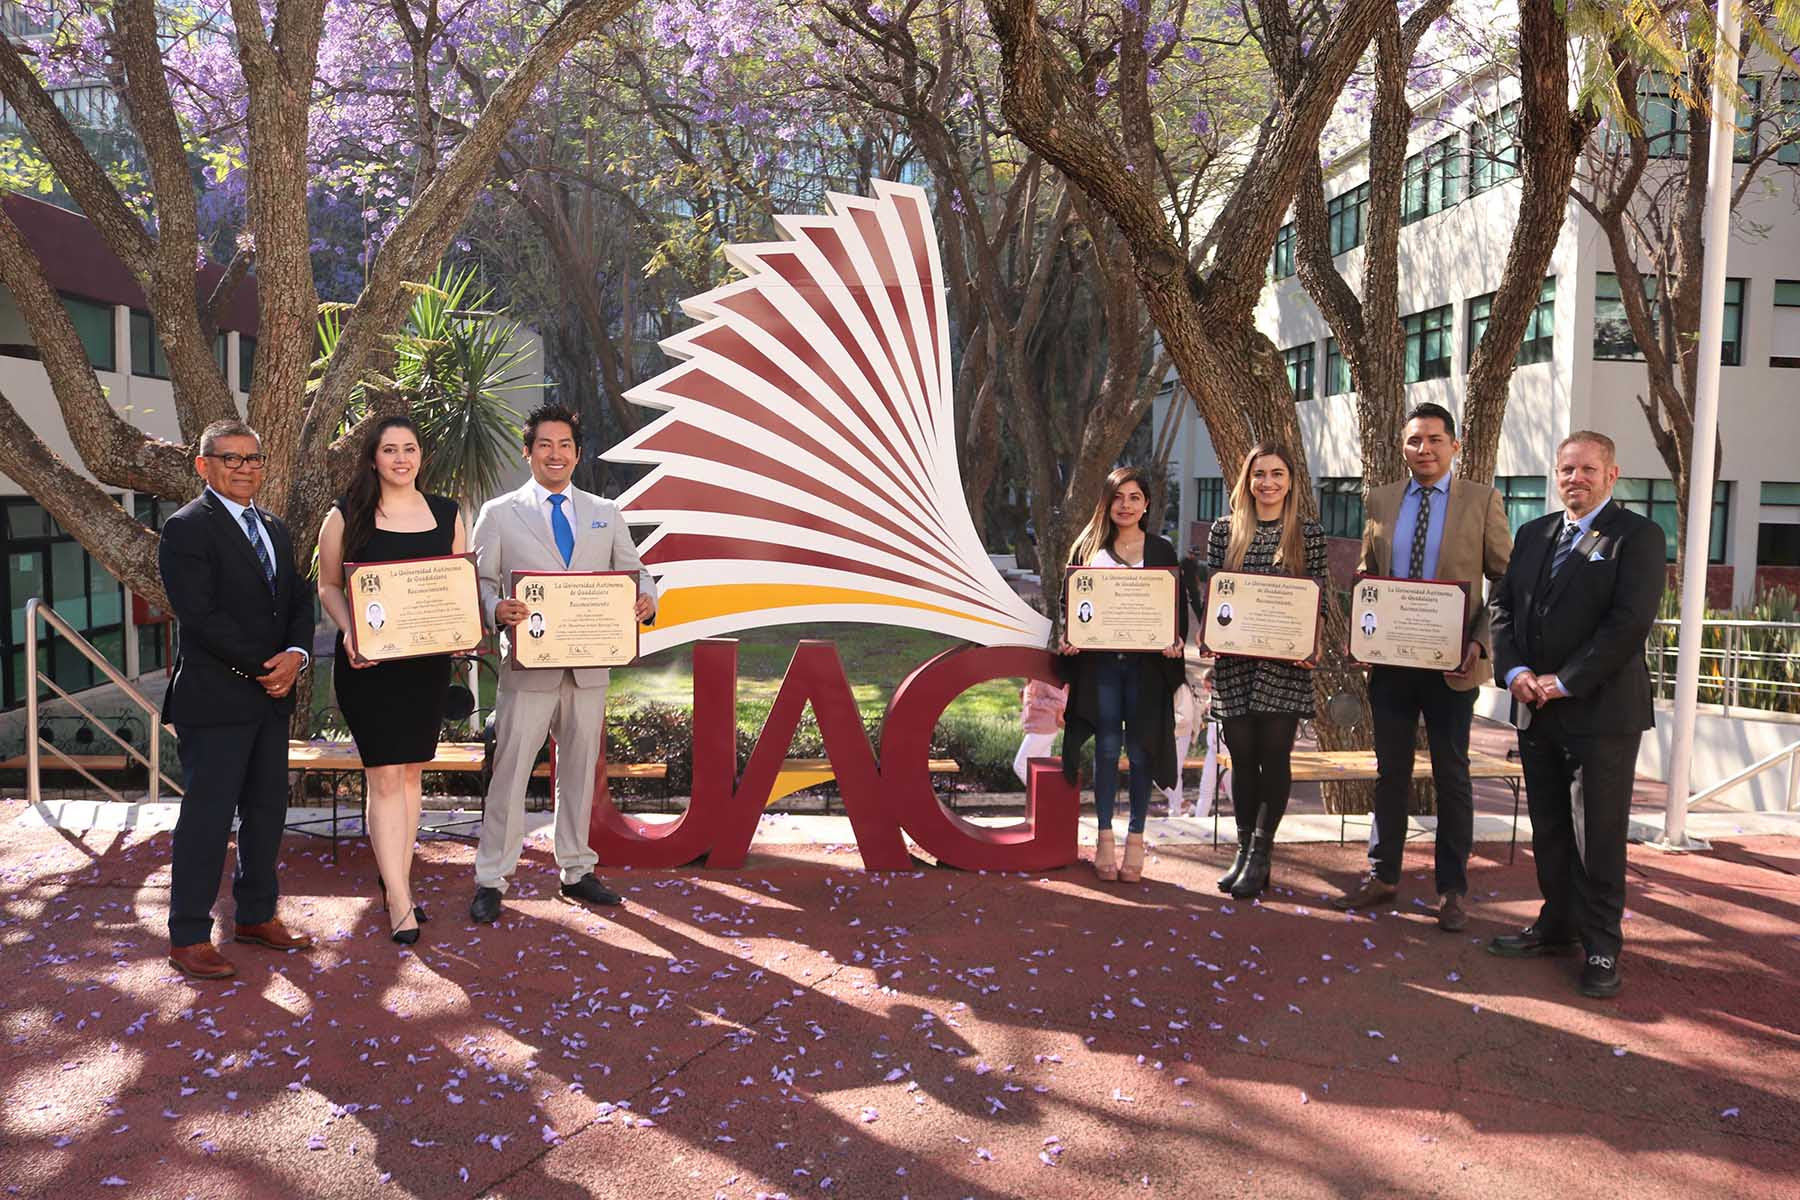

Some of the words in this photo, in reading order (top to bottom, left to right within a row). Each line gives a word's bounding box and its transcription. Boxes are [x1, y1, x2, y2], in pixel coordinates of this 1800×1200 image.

[399, 568, 432, 576] Universidad
[414, 574, 447, 582] Guadalajara
[550, 638, 1080, 872] UAG
